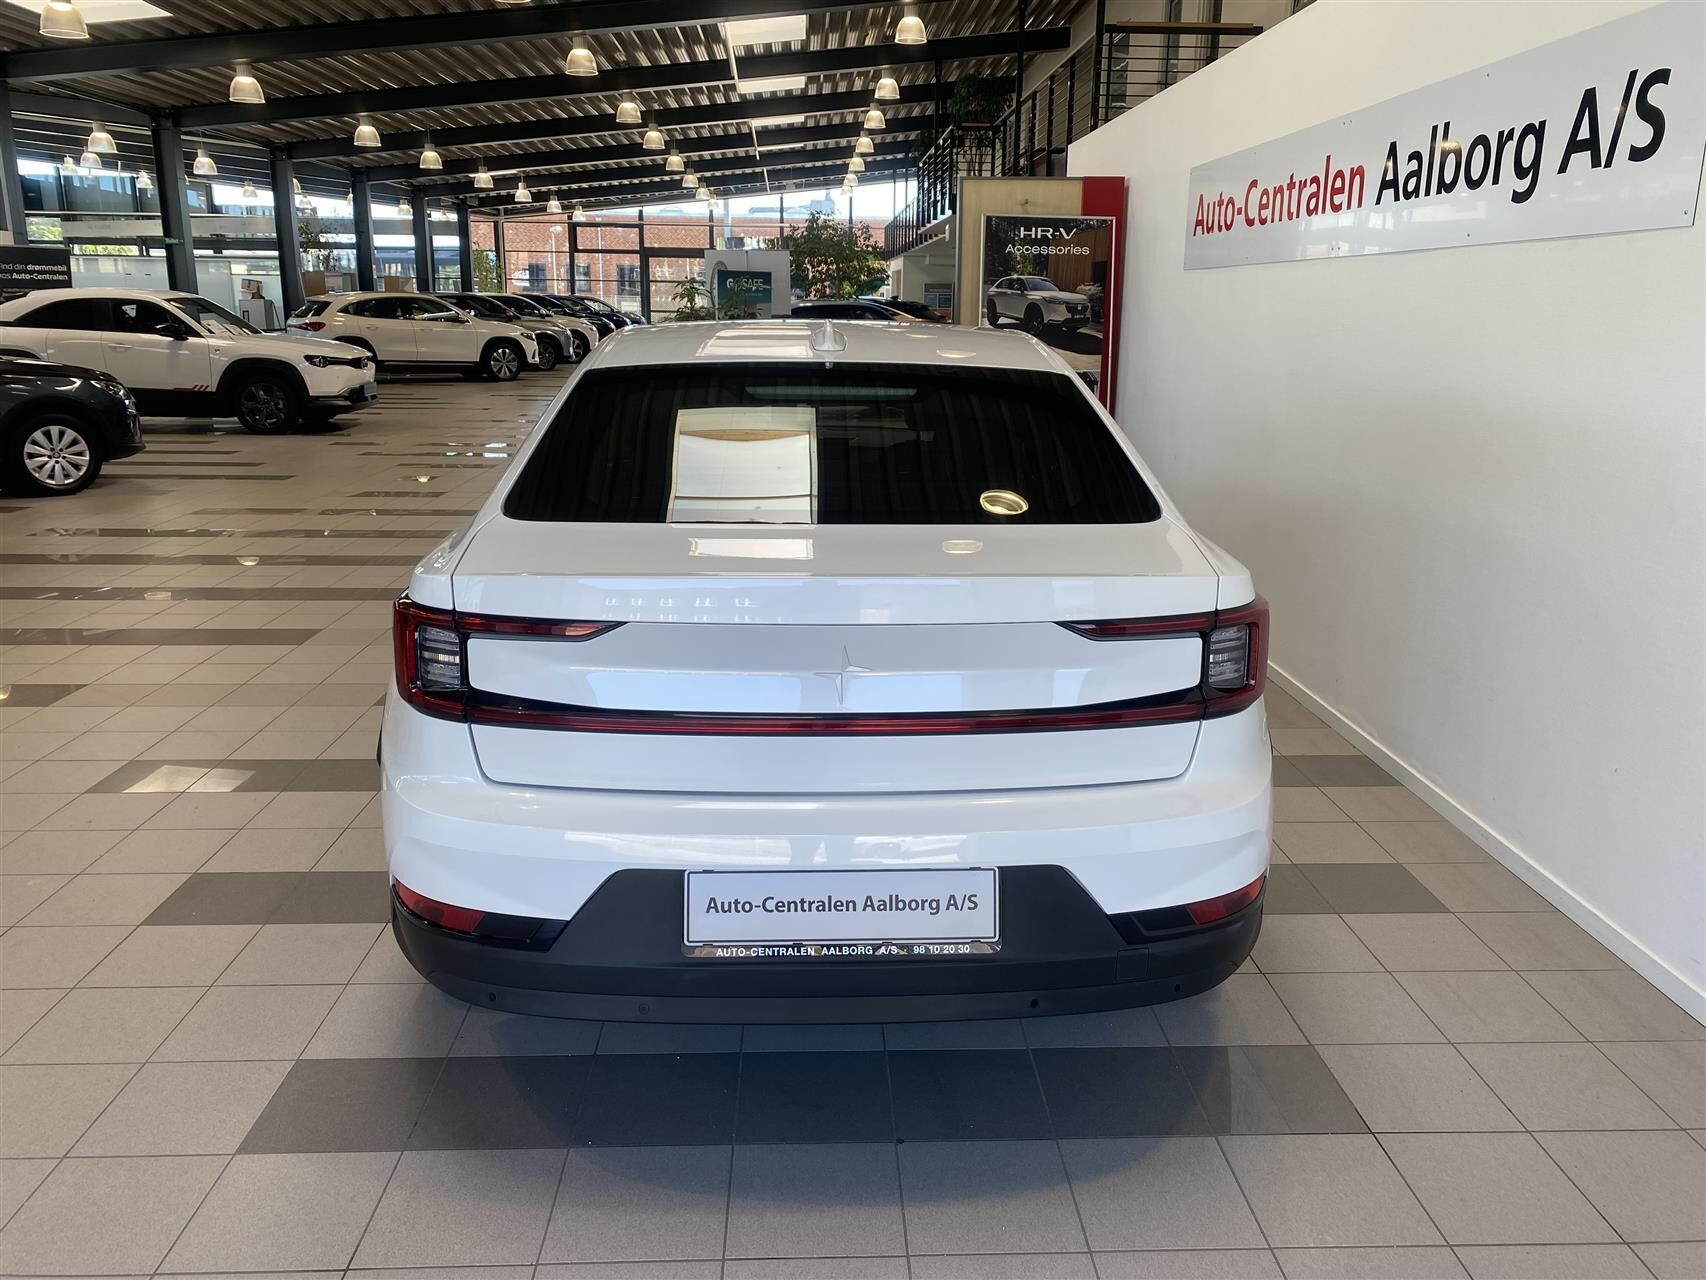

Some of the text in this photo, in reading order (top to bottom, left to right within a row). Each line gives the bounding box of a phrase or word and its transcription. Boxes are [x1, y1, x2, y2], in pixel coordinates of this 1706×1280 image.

[1193, 67, 1672, 236] Auto-Centralen Aalborg A/S
[1020, 226, 1077, 239] HR-V
[1005, 244, 1090, 255] Accessories
[12, 272, 69, 281] Auto-Centralen
[705, 893, 979, 915] Auto-Centralen Aalborg A/S
[716, 944, 970, 957] AUTO-CENTRALEN AALBORG A/S 98 10 20 30
